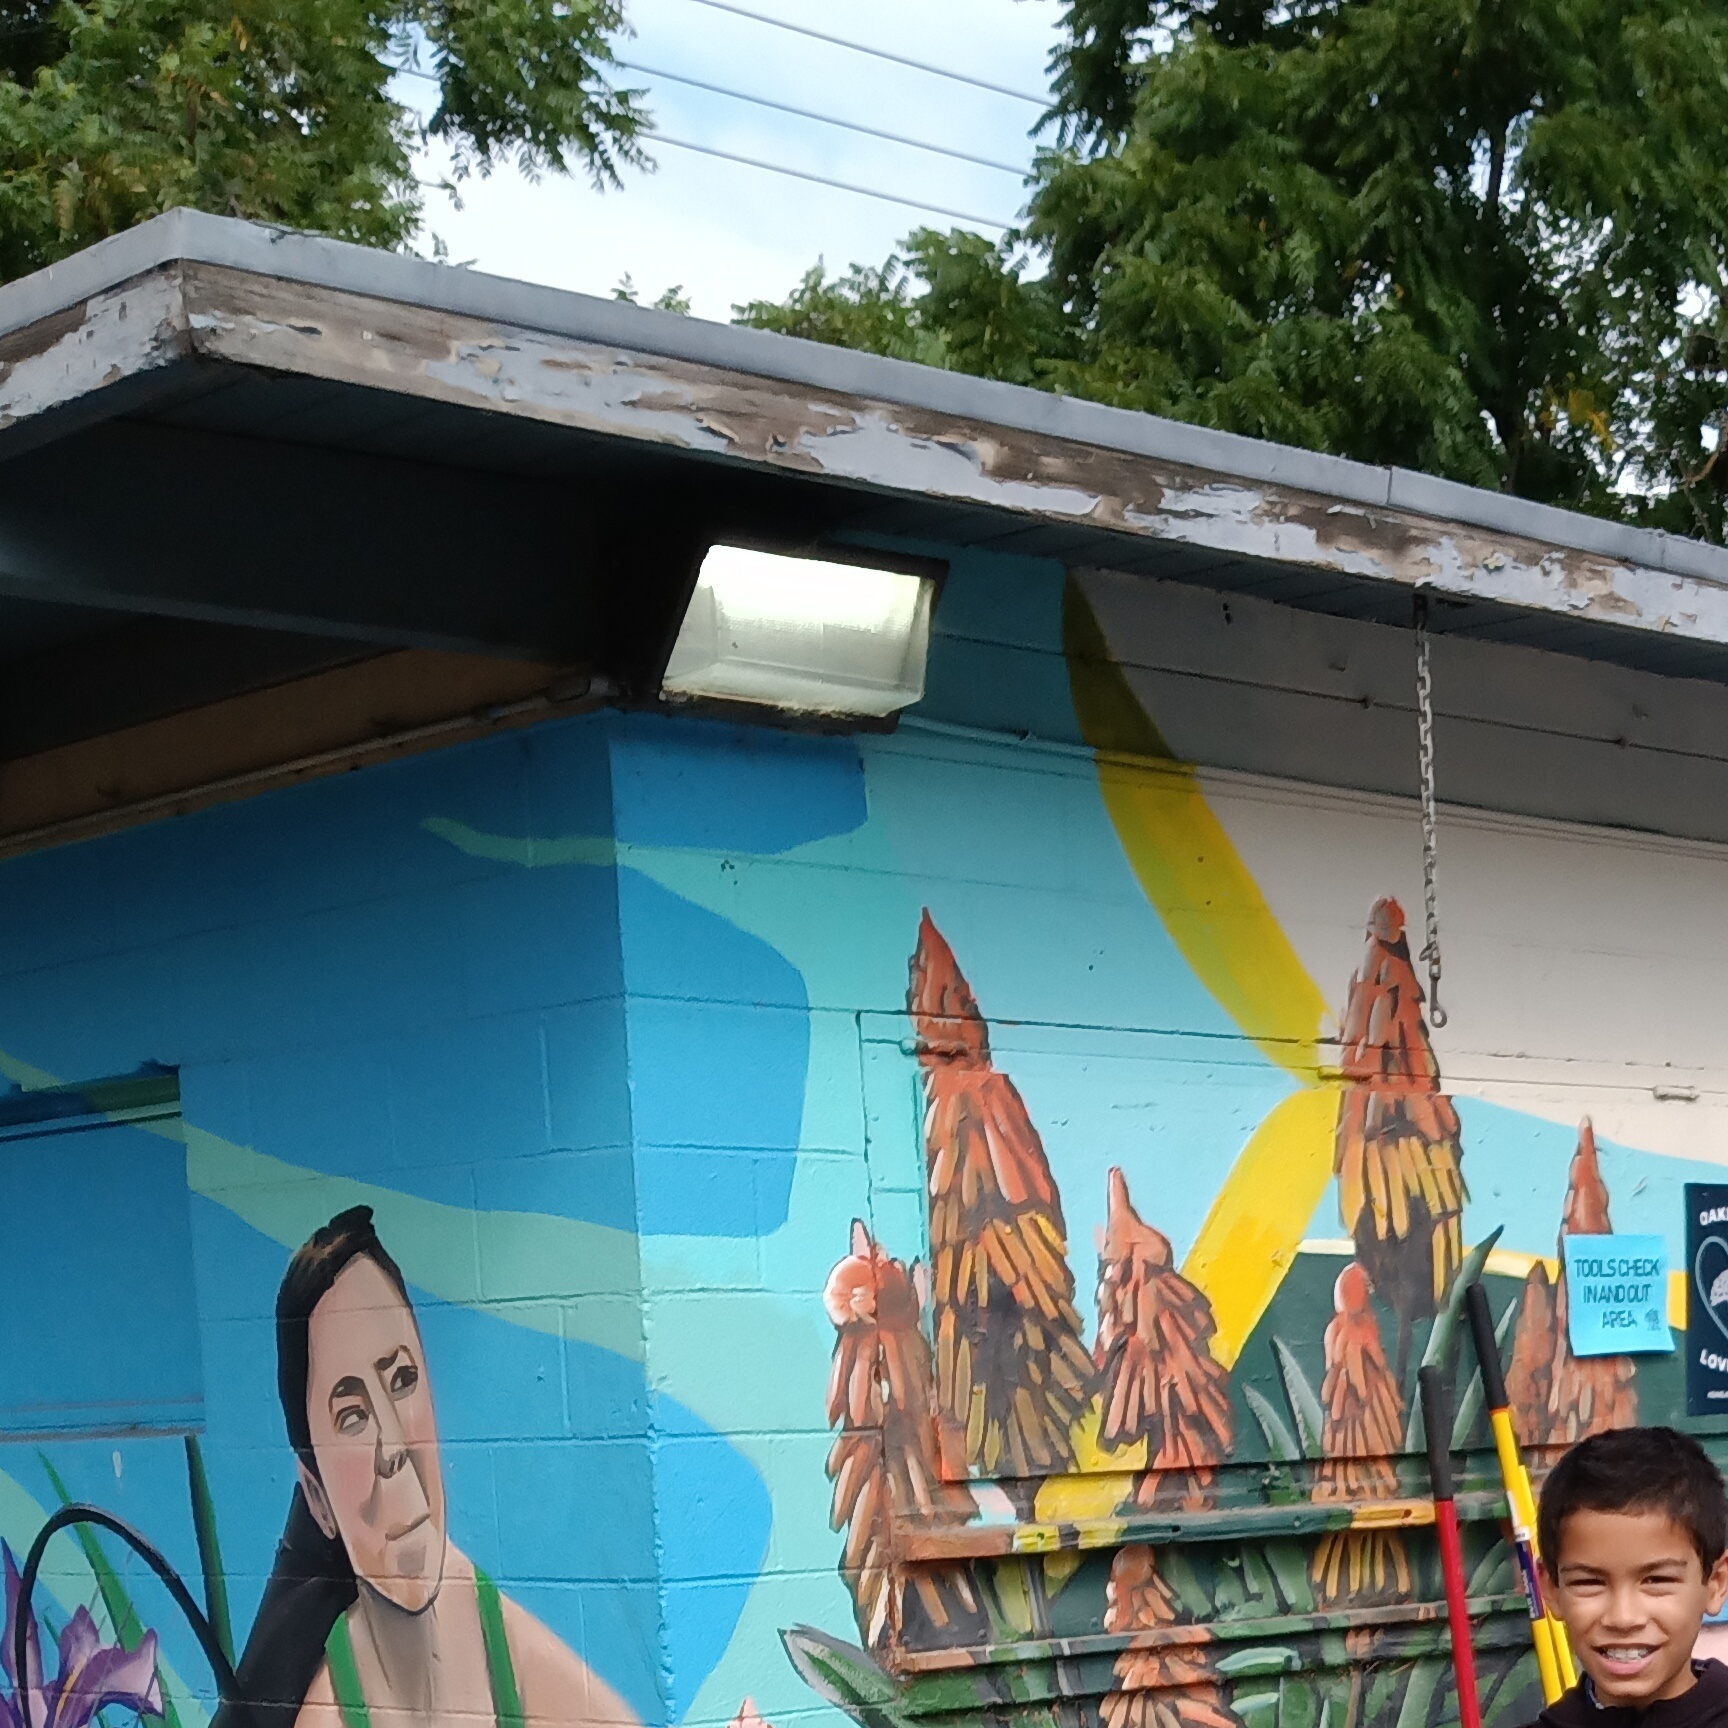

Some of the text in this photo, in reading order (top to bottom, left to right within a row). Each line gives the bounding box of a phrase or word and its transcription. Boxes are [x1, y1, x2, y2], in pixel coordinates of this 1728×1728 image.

[1574, 1258, 1660, 1278] TOOLS CHECK
[1583, 1283, 1652, 1304] IN AND OUT
[1602, 1309, 1638, 1329] AREA
